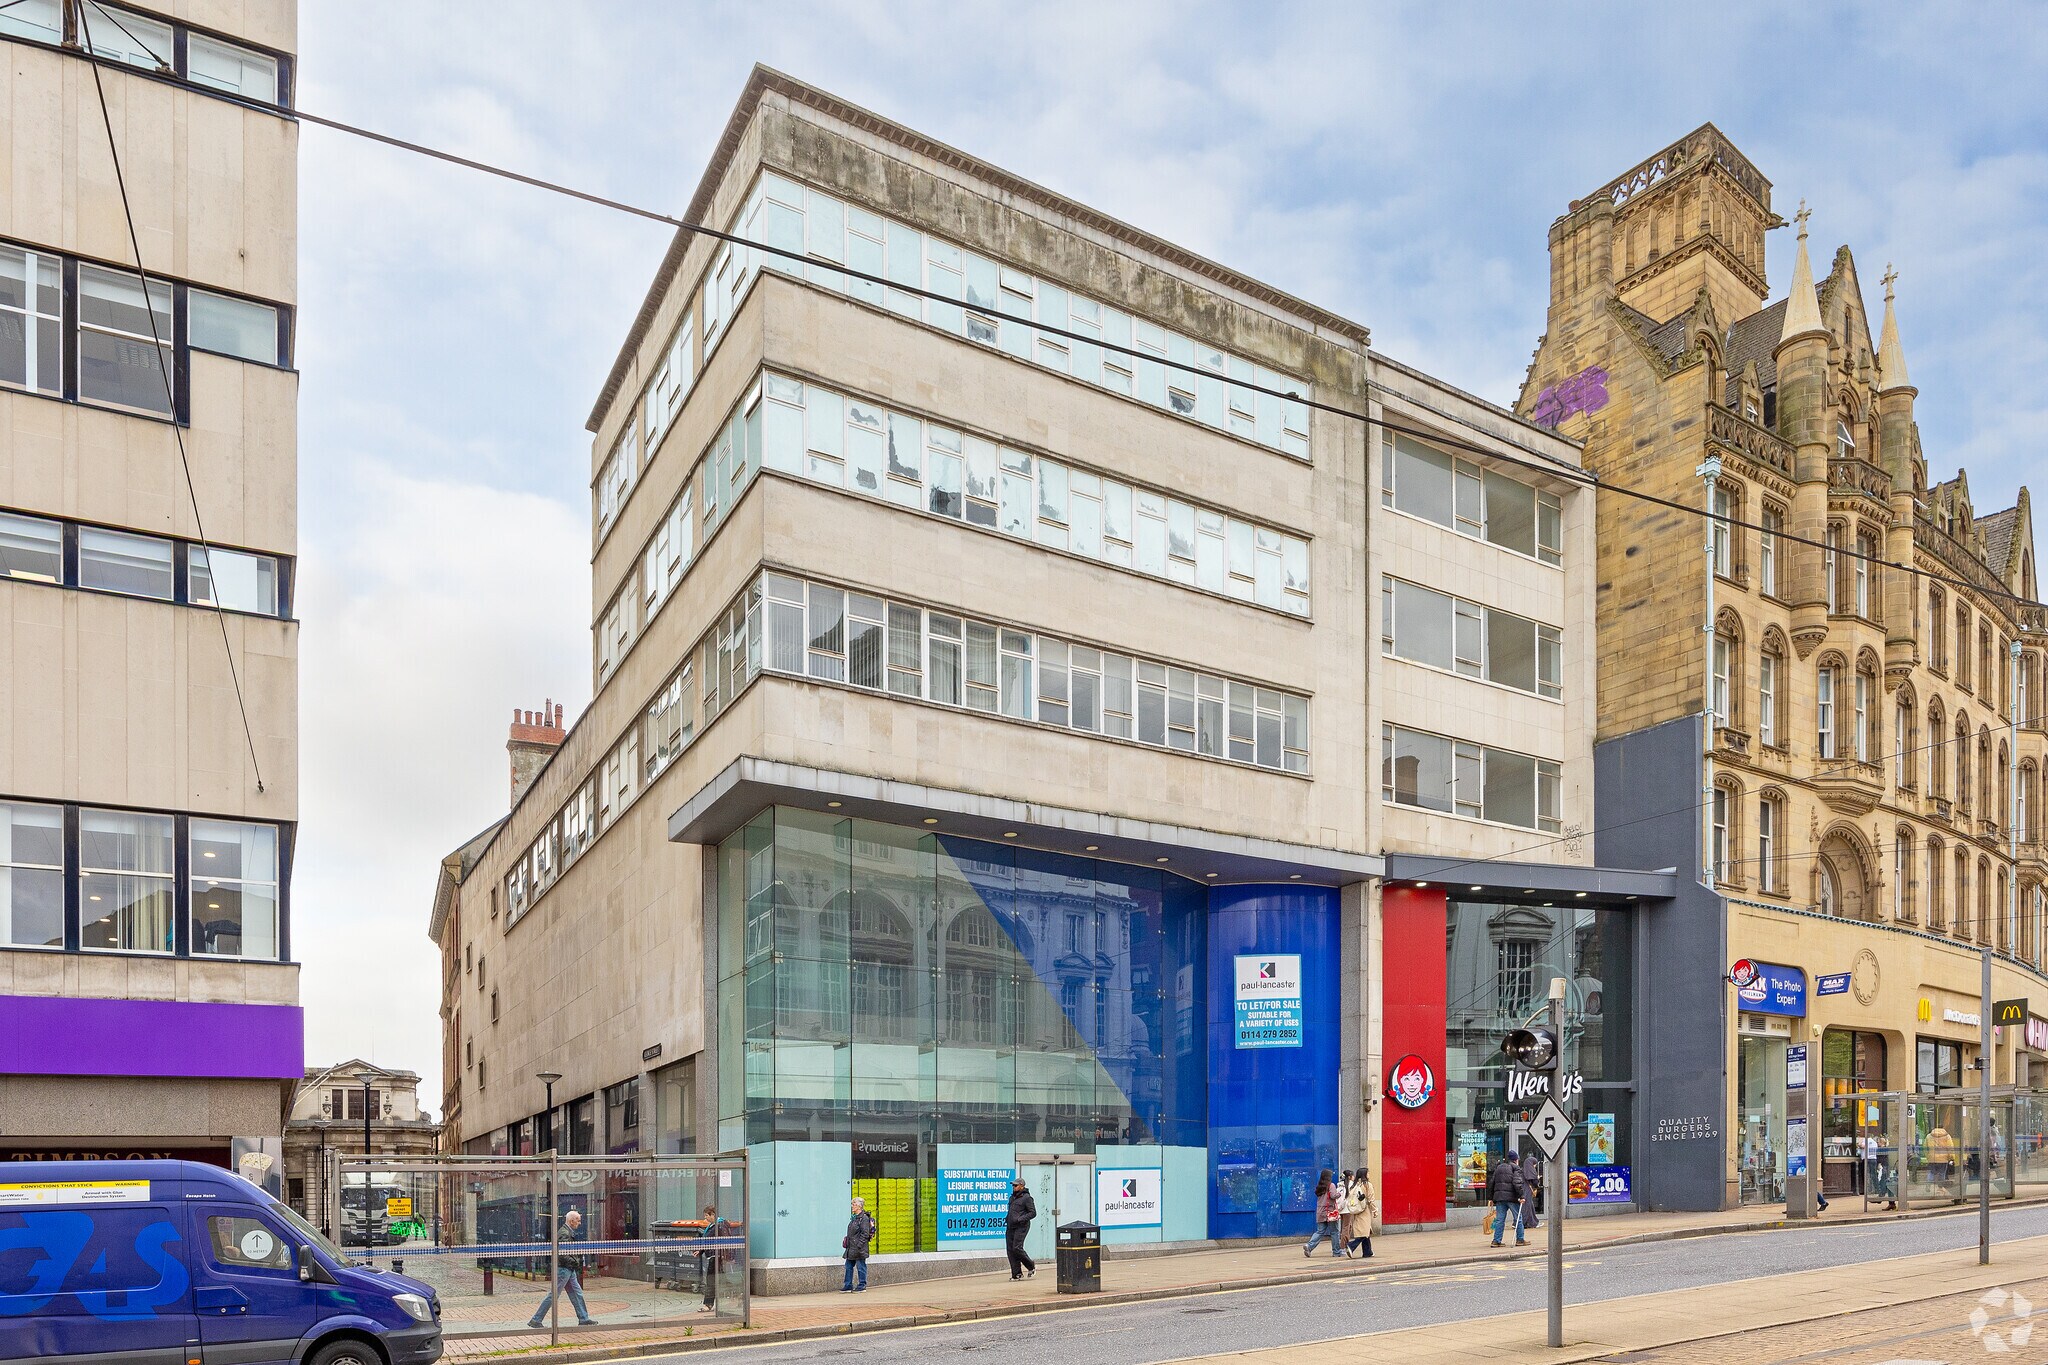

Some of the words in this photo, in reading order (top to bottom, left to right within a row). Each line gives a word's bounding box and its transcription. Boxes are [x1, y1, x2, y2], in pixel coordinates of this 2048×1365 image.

[1241, 980, 1296, 991] paul-lancaster
[1771, 978, 1783, 989] The
[1784, 980, 1802, 992] Photo
[1823, 978, 1845, 986] MAX
[1776, 993, 1797, 1006] Expert
[1237, 1002, 1247, 1010] TO
[1249, 1001, 1281, 1010] LET/FOR
[1283, 1000, 1301, 1009] SALE
[1248, 1011, 1278, 1019] SUITABLE
[1240, 1020, 1245, 1028] A
[1245, 1019, 1273, 1027] VARIETY
[1241, 1030, 1261, 1039] 0114
[1263, 1030, 1277, 1038] 279
[1279, 1029, 1297, 1038] 2852
[1507, 1070, 1584, 1103] Weny's
[1659, 1116, 1709, 1126] QUALITY
[1543, 1116, 1556, 1141] 5
[1658, 1123, 1711, 1134] BURGERS
[1651, 1132, 1687, 1141] SINCE
[1691, 1130, 1718, 1139] 1969
[943, 1170, 986, 1179] SUBSTANTIAL
[987, 1170, 1011, 1178] RETAIL/
[947, 1181, 974, 1190] LEISURE
[975, 1181, 1007, 1190] PREMISES
[1590, 1177, 1625, 1192] 2.00
[946, 1193, 955, 1202] TO
[956, 1193, 968, 1201] LET
[969, 1193, 978, 1201] OR
[979, 1193, 992, 1201] FOR
[993, 1193, 1009, 1201] SALE
[941, 1204, 979, 1213] INCENTIVES
[980, 1204, 1009, 1213] AVAILABL
[1104, 1199, 1155, 1214] paul-lancaster
[947, 1218, 968, 1229] 0114
[970, 1217, 986, 1228] 279
[987, 1217, 1008, 1228] 2852
